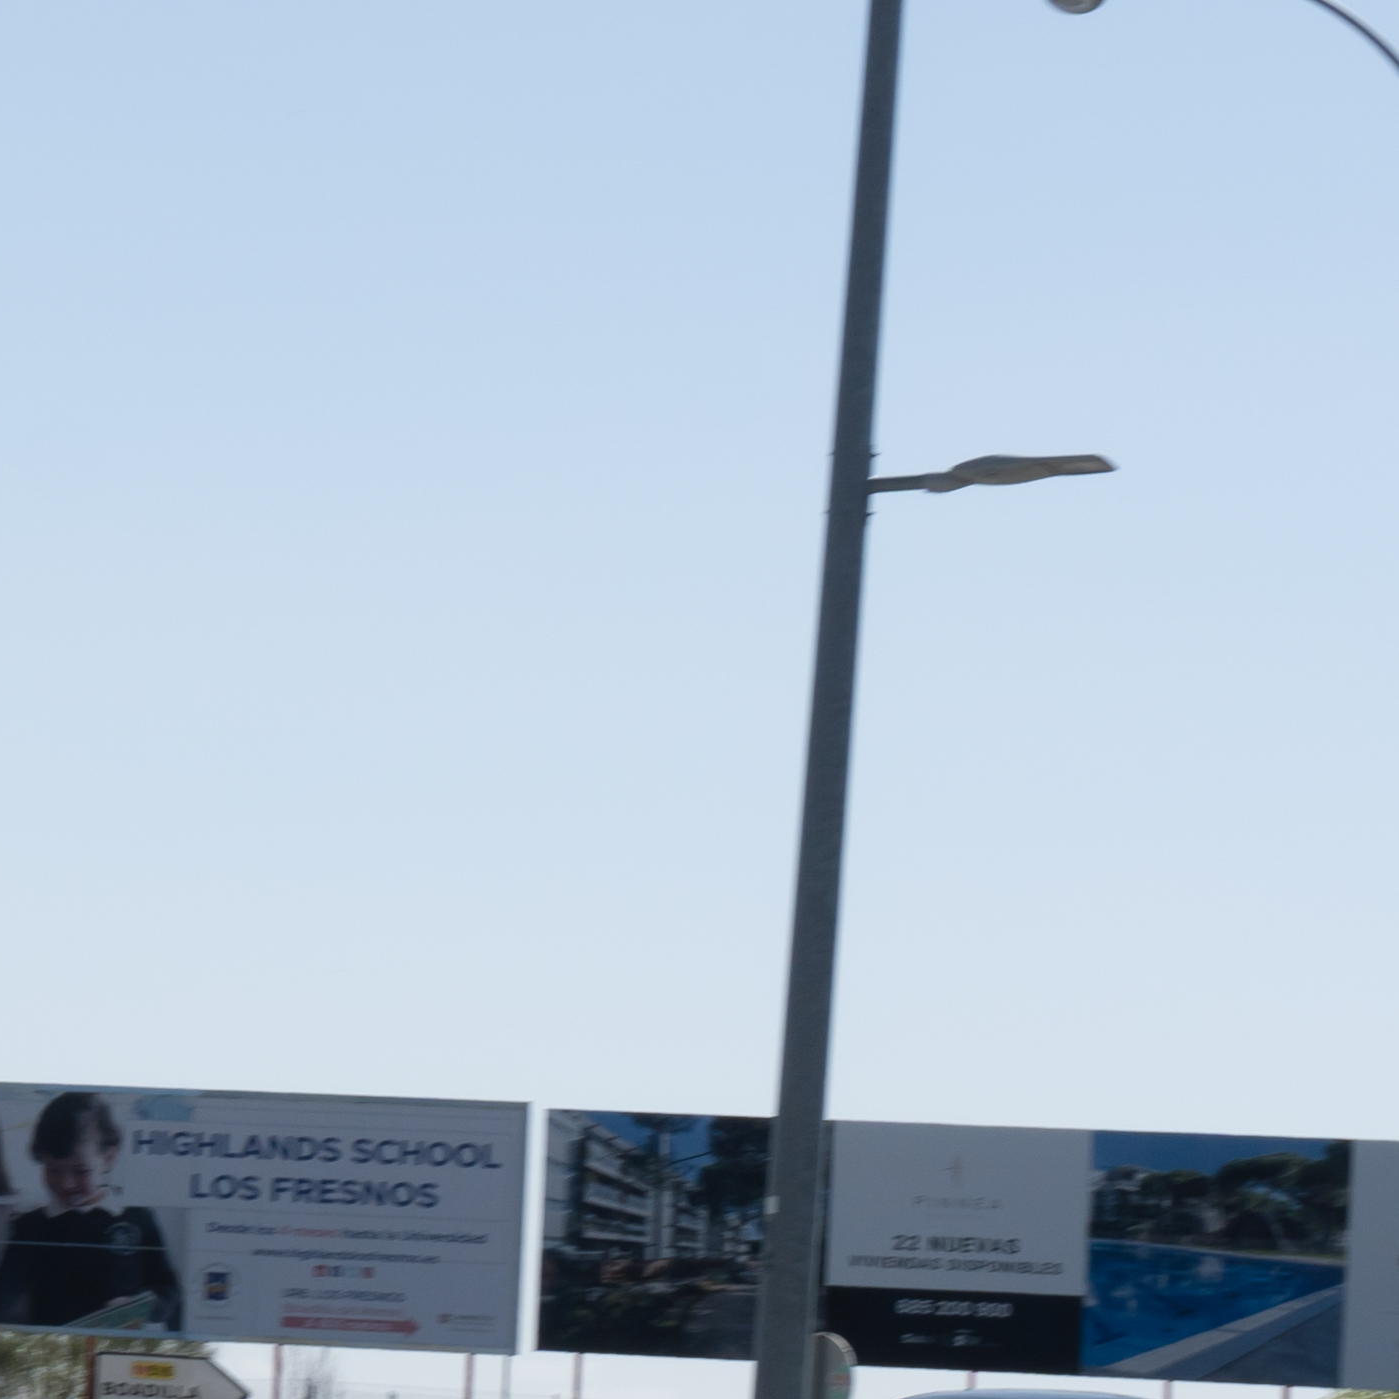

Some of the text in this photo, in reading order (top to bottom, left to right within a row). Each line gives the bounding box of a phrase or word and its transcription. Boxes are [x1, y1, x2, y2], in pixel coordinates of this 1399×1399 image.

[131, 1129, 503, 1169] HIGHLANDS SCHOOL
[188, 1173, 441, 1209] LOS FRESNOS
[891, 1234, 1022, 1255] 22 NUEVAS
[944, 1258, 1065, 1276] DISPONIBLES
[102, 1381, 202, 1399] BOADILLA
